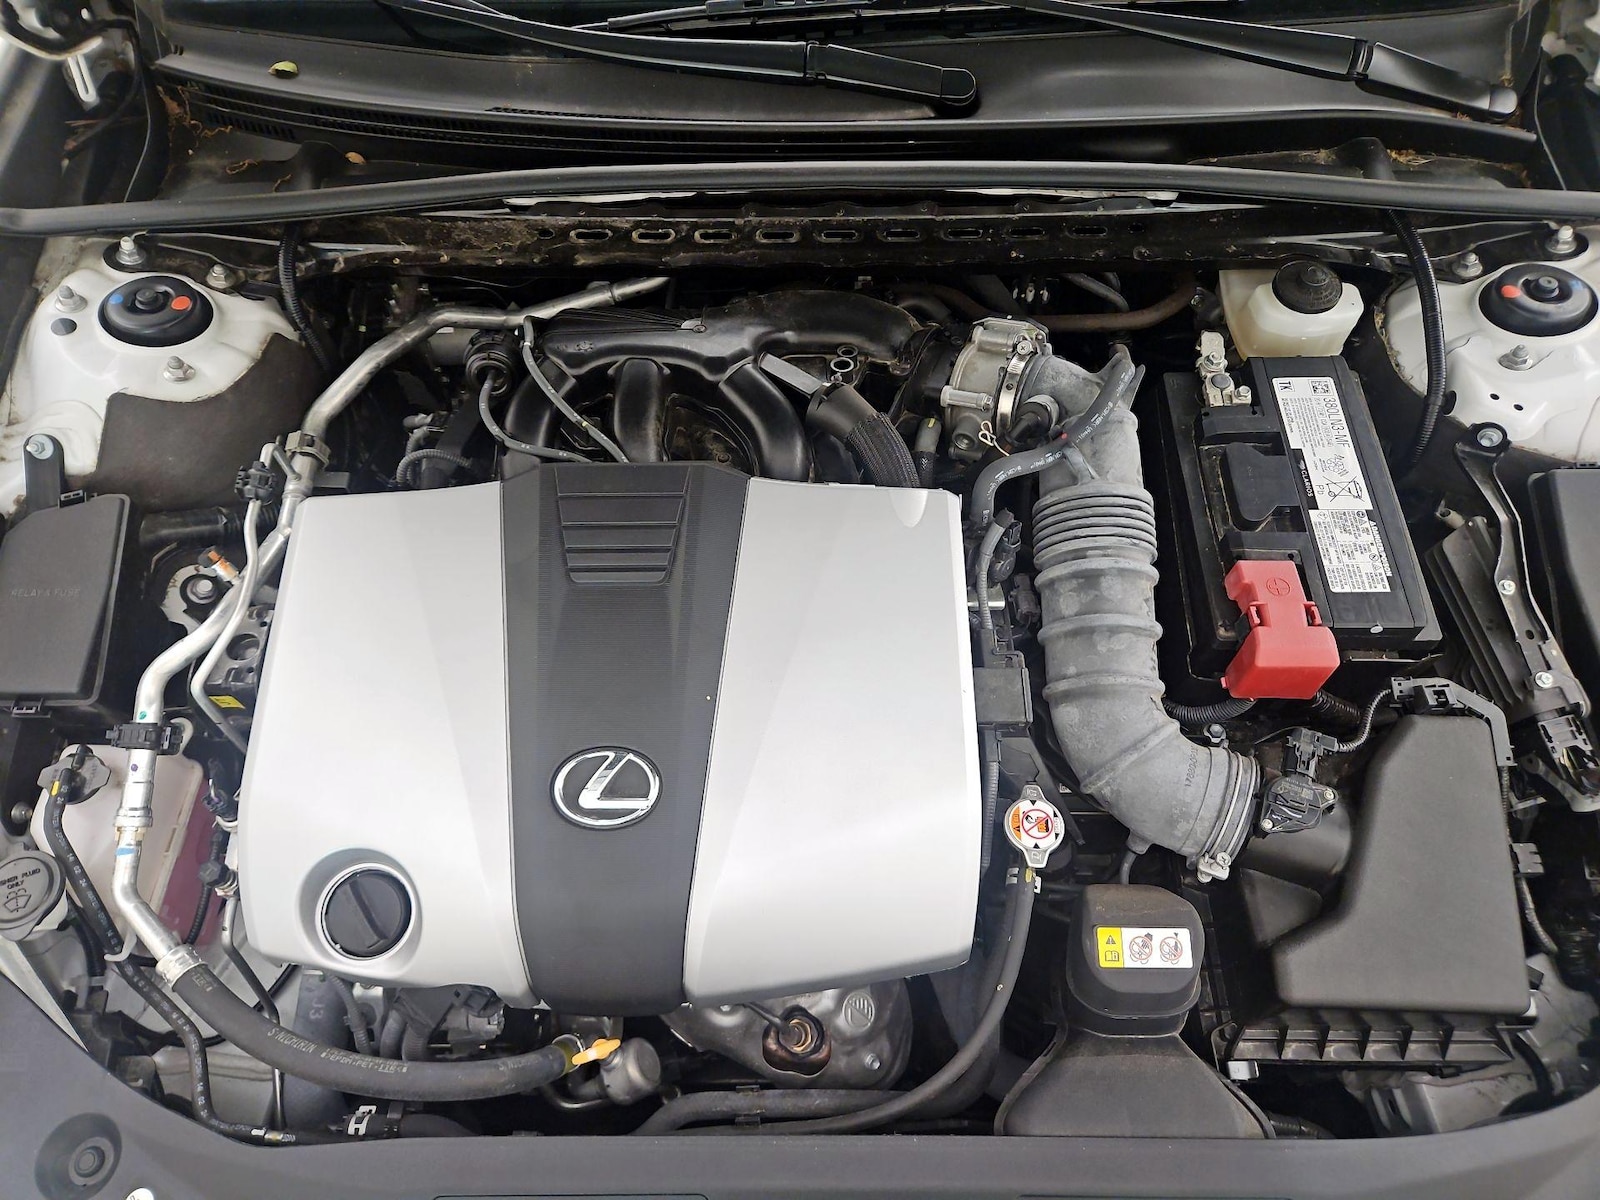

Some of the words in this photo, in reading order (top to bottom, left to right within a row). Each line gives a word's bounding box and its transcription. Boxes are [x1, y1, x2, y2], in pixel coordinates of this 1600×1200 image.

[1279, 381, 1292, 391] TK
[1323, 397, 1350, 448] 380LN3-MF
[1301, 470, 1313, 497] CLARIOS
[1316, 484, 1326, 495] Pb
[7, 879, 25, 890] ONLY
[310, 999, 324, 1019] J3
